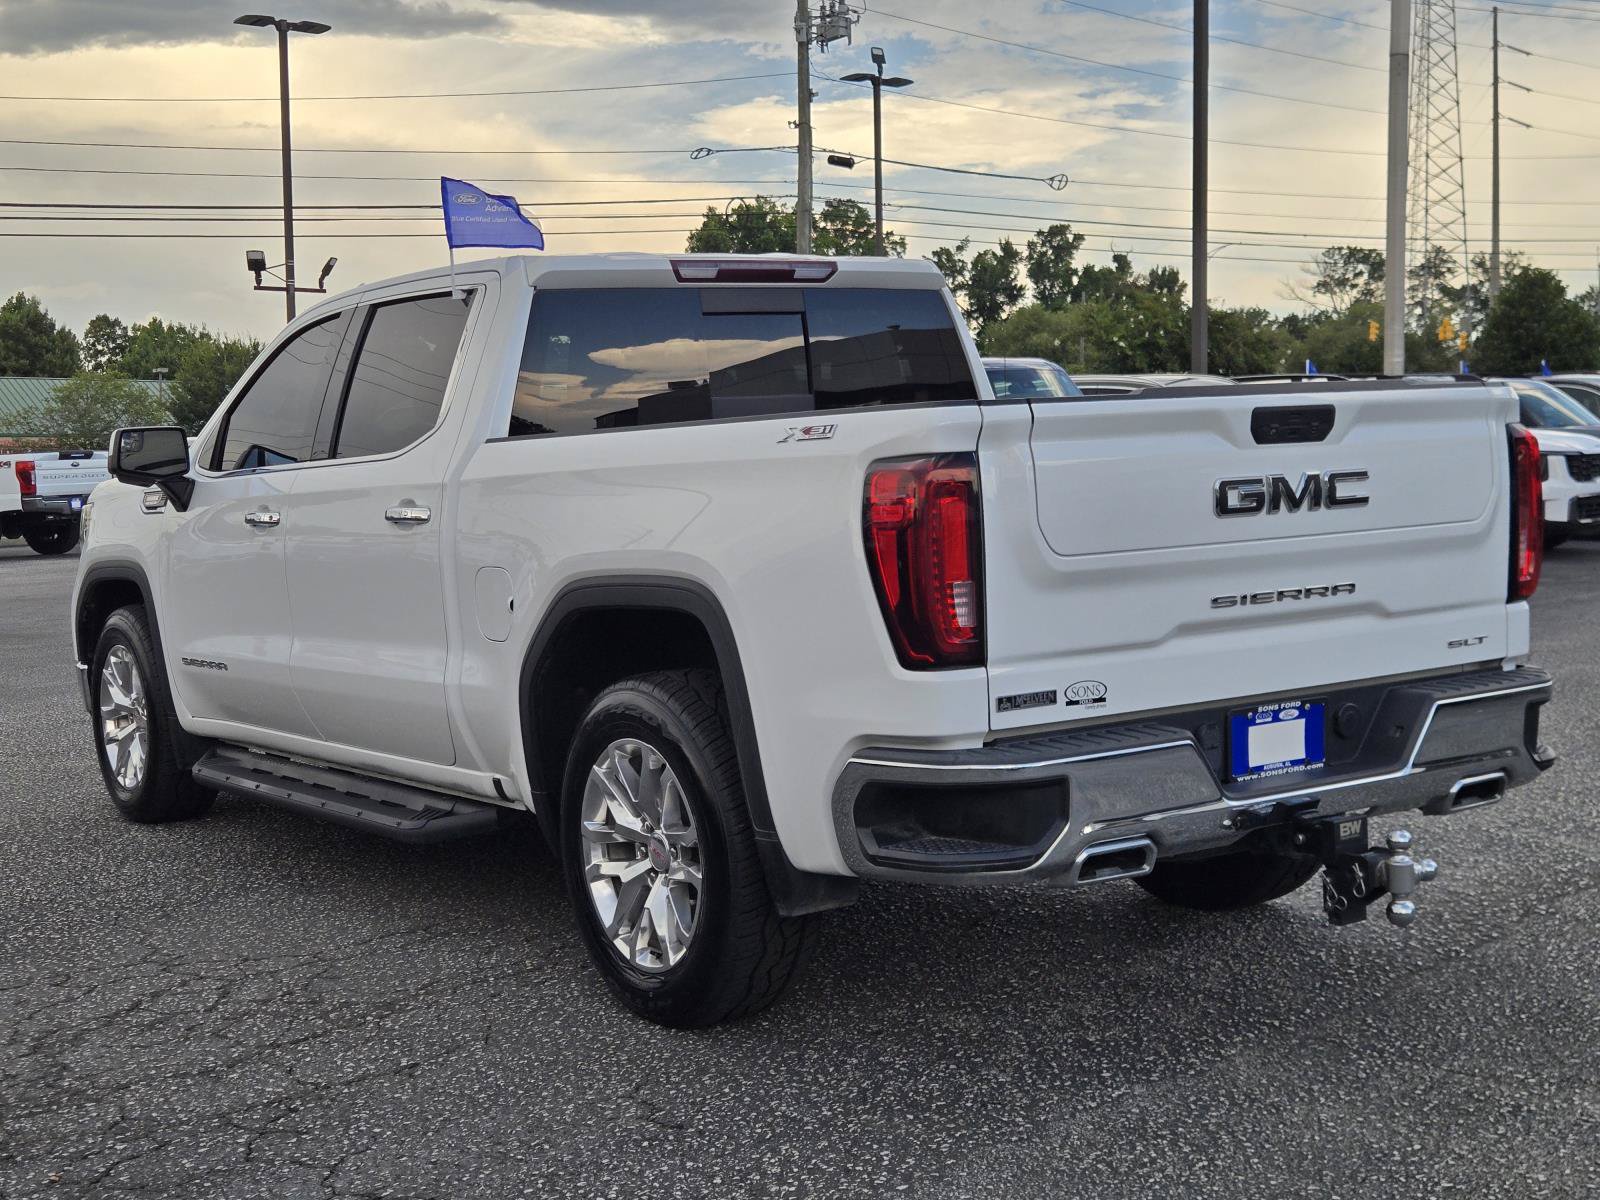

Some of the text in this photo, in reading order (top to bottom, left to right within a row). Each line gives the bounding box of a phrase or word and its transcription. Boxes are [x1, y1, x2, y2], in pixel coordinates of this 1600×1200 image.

[1213, 470, 1369, 519] GMC
[1210, 582, 1356, 609] SIERRA
[1447, 635, 1488, 649] SLT
[181, 657, 229, 672] SIERRA
[1071, 684, 1101, 698] SONS
[1280, 701, 1301, 709] FORD
[1237, 763, 1324, 781] www.SONSFORD.com
